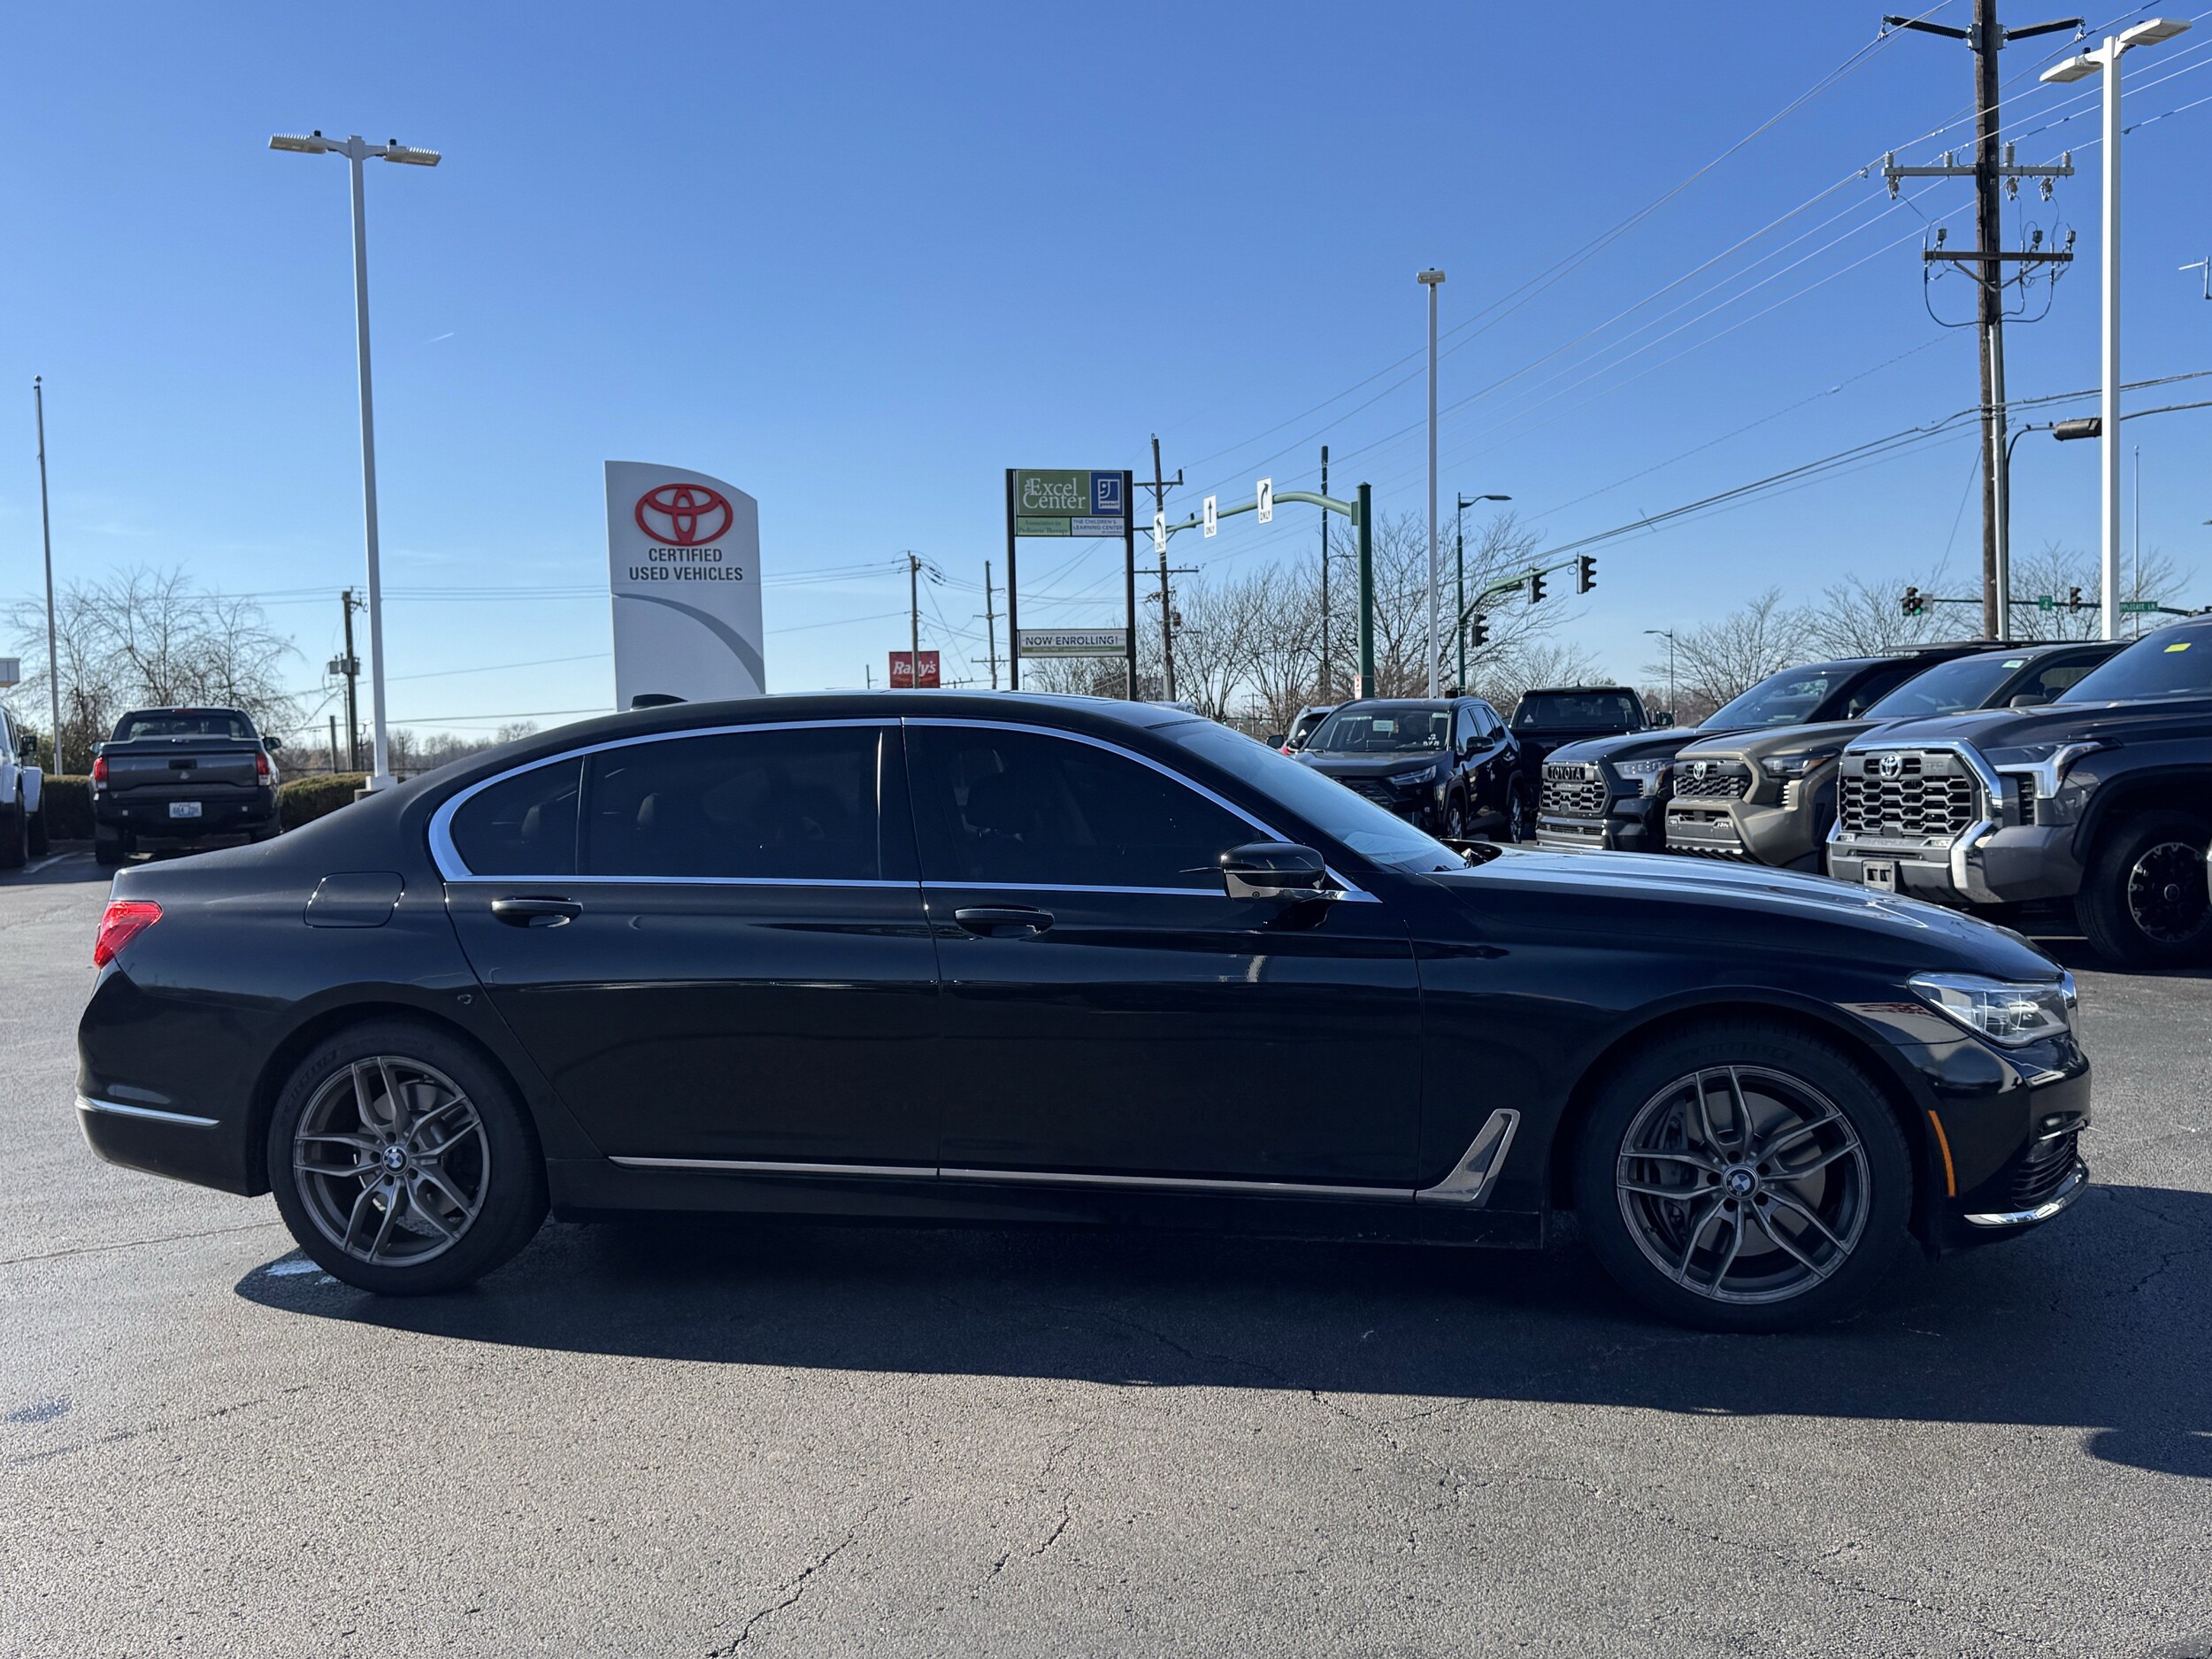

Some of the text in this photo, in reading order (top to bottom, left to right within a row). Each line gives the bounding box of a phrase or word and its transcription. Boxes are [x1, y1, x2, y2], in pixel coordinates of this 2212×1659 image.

[1029, 477, 1079, 495] Excel
[1022, 491, 1087, 509] Center
[649, 548, 723, 562] CERTIFIED
[629, 566, 743, 580] USED VEHICLES
[1025, 635, 1118, 646] NOW ENROLLING!
[892, 660, 936, 678] Raly's
[1550, 766, 1581, 780] TOYOTA
